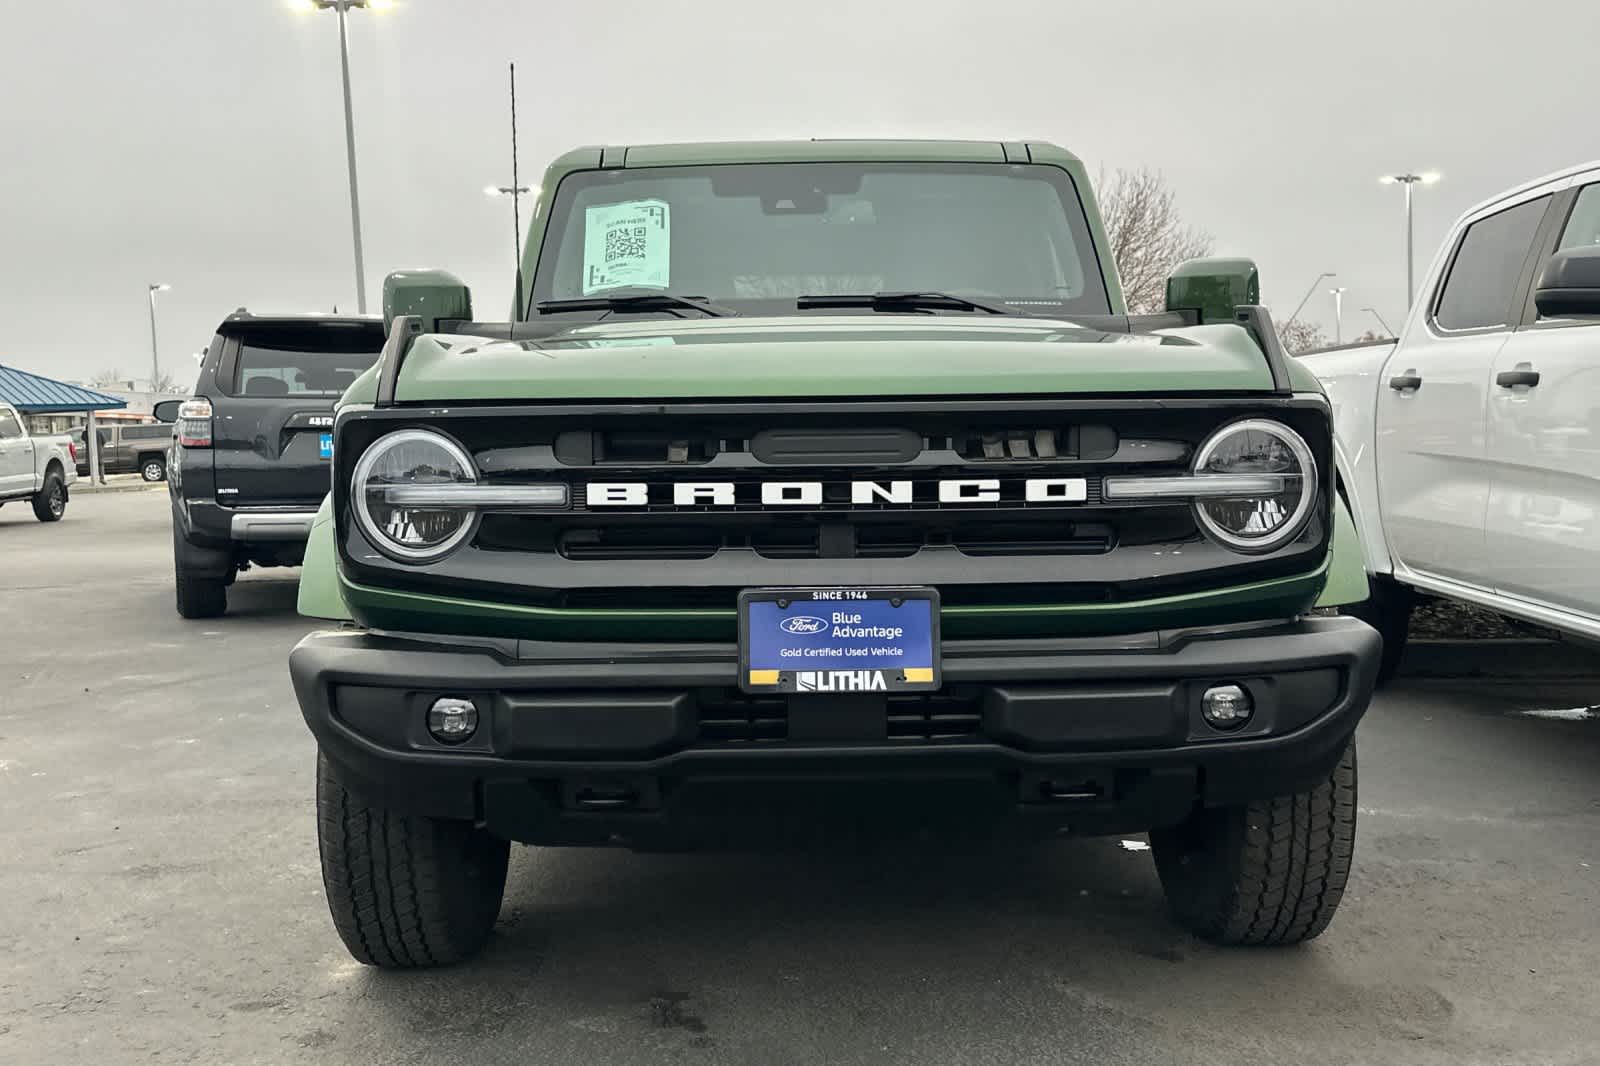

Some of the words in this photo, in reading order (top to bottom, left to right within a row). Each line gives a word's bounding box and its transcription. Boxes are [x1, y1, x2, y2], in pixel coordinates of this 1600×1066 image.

[586, 478, 1087, 506] BRONCO
[812, 591, 843, 600] SINCE
[845, 591, 868, 600] 1946
[832, 612, 862, 624] Blue
[789, 618, 819, 632] Ford
[832, 626, 903, 639] Advantage
[780, 648, 801, 657] Gold
[804, 648, 842, 657] Certified
[845, 647, 868, 656] Used
[871, 647, 903, 656] Vehicle
[817, 670, 888, 691] LITHIA
